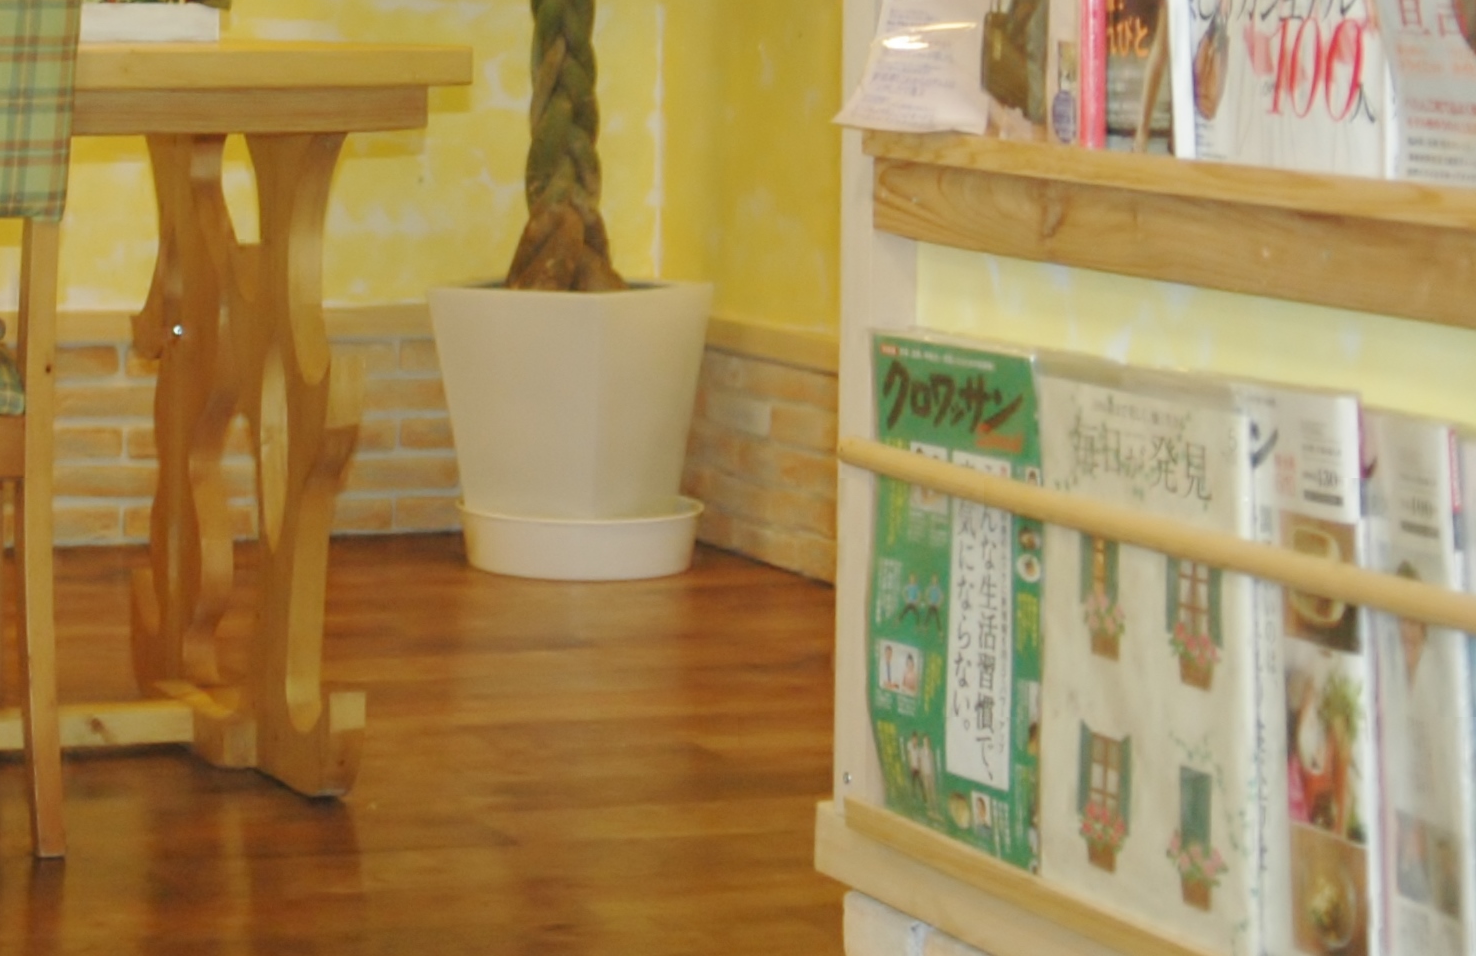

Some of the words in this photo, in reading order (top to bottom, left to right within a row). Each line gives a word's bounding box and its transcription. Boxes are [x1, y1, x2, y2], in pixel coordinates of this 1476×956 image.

[882, 359, 1024, 435] クロワッサン
